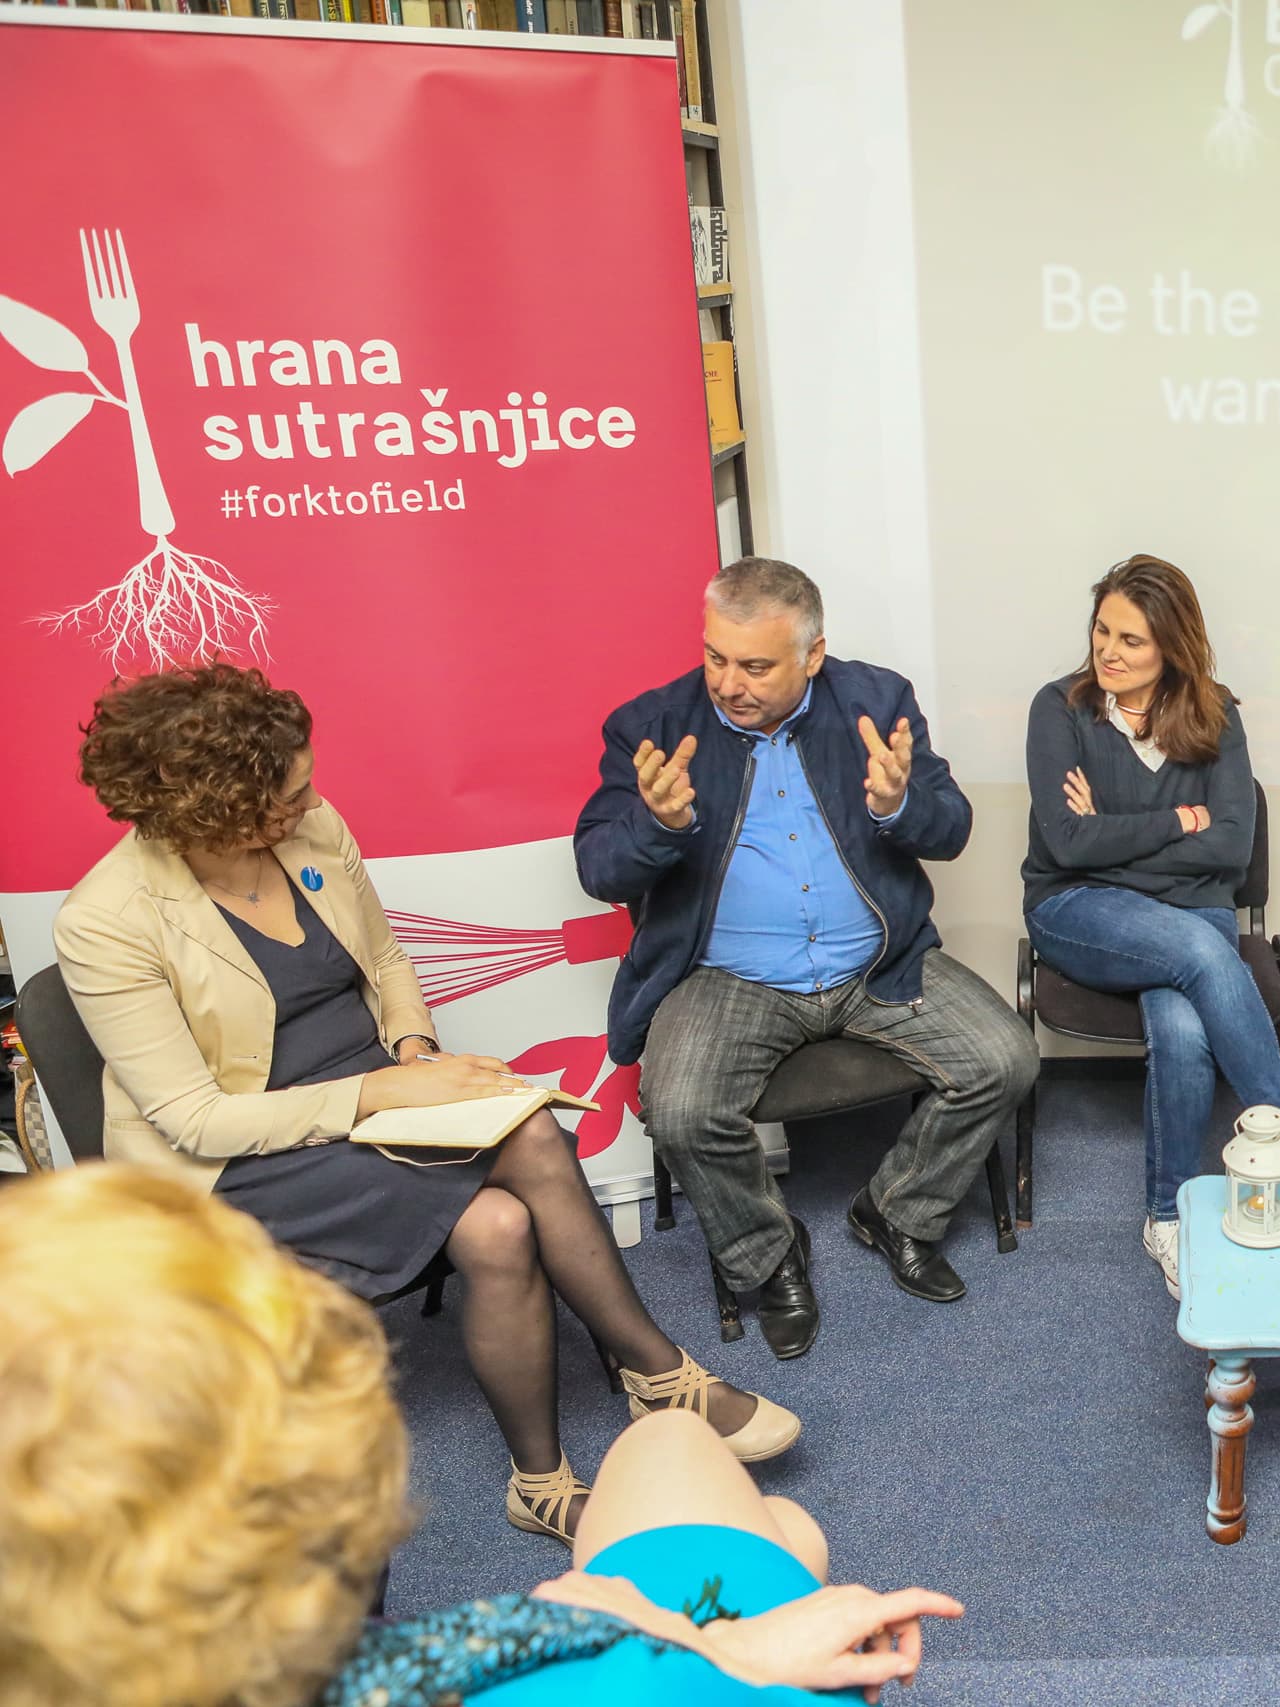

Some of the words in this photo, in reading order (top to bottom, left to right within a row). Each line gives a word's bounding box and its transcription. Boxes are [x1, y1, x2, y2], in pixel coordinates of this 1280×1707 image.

[1042, 264, 1128, 333] Be
[1150, 269, 1260, 337] the
[185, 323, 401, 387] hrana
[204, 389, 635, 468] sutrašnjice
[221, 479, 465, 518] #forktofield
